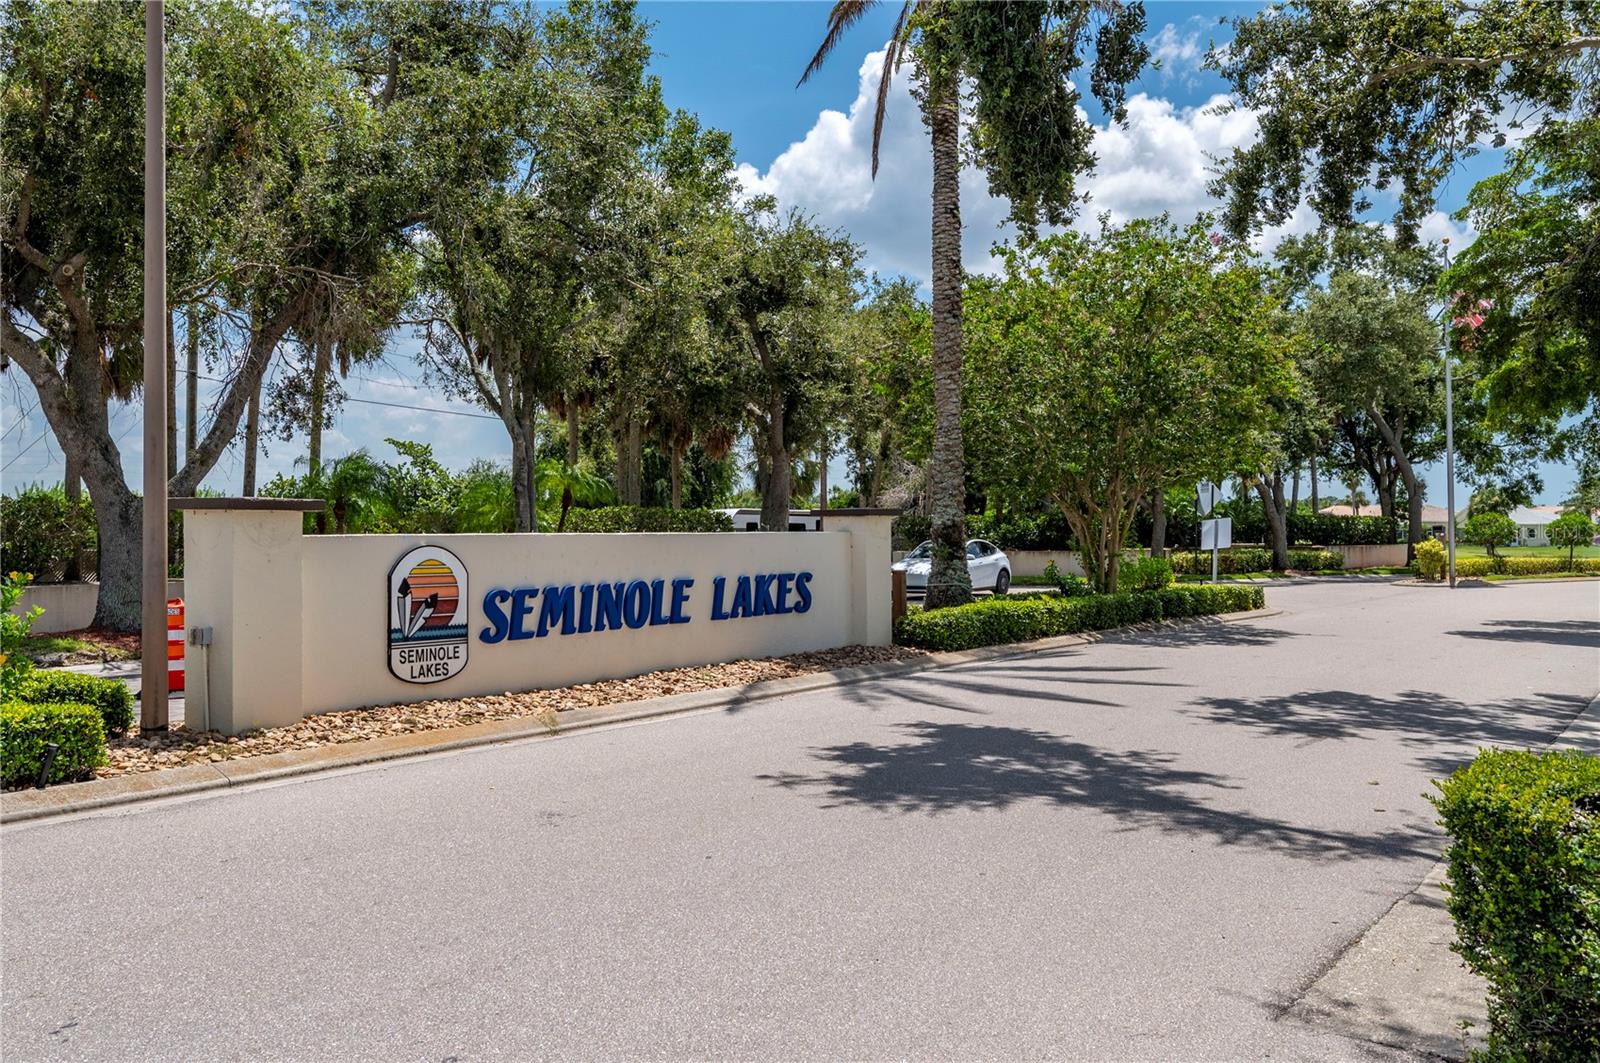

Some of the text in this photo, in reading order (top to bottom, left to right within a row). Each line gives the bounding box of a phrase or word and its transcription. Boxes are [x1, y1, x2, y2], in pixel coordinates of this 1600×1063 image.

[478, 571, 813, 644] SEMINOLE LAKES
[399, 646, 460, 664] SEMINOLE
[410, 662, 449, 679] LAKES
